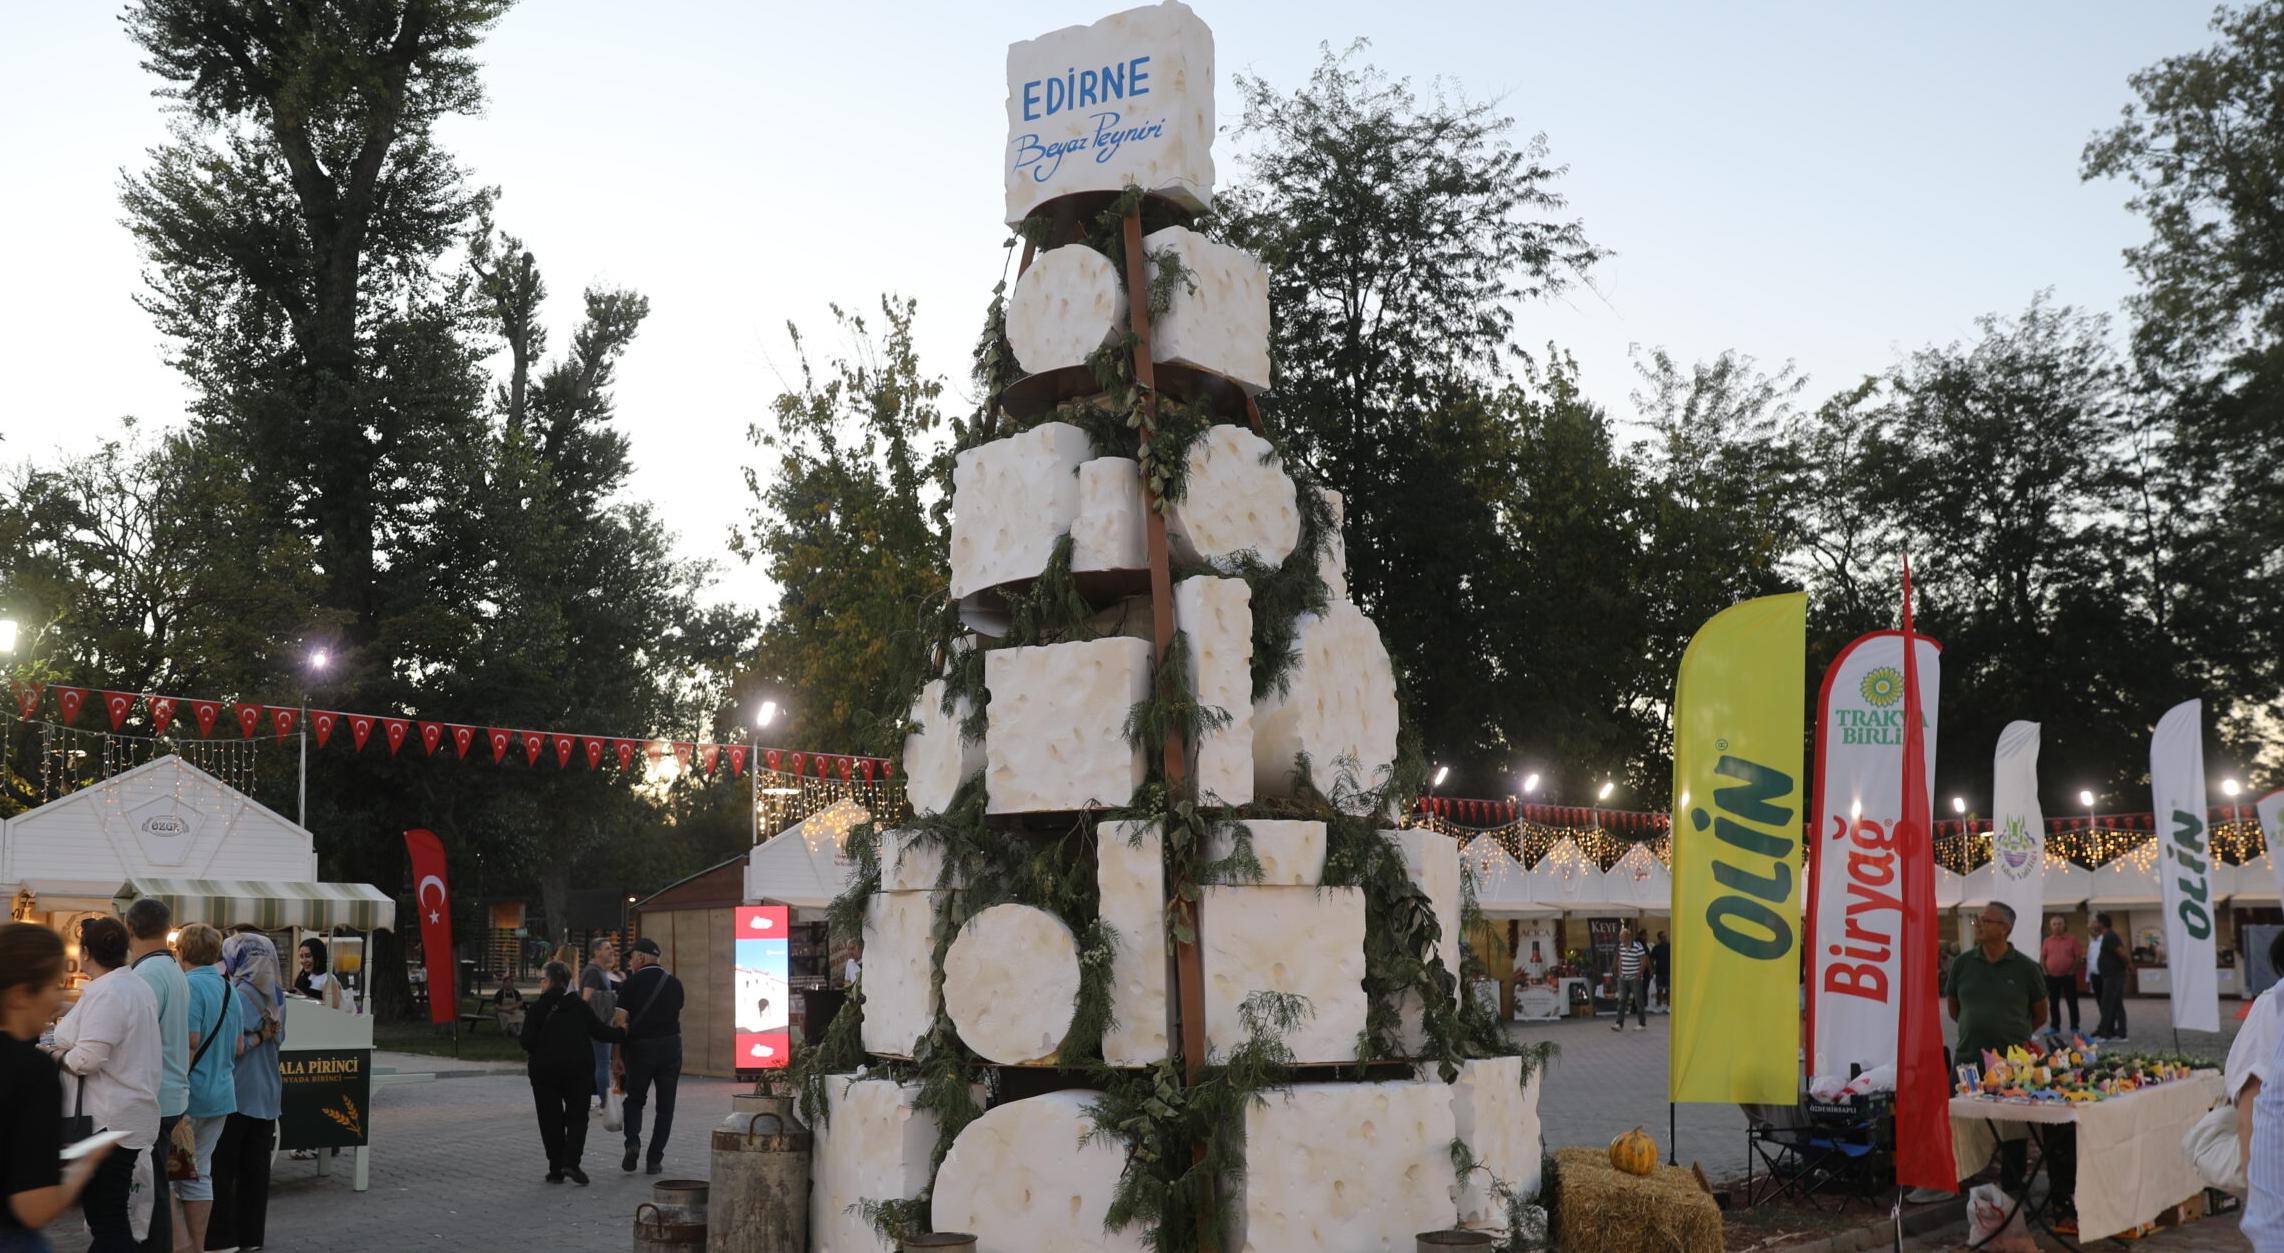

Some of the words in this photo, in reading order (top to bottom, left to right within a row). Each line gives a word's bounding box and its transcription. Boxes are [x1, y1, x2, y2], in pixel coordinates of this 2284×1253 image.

[1023, 56, 1150, 121] EDİRNE
[1012, 133, 1088, 182] Beyaz
[1088, 112, 1166, 164] Peyniri
[1691, 755, 1794, 960] OLİN
[2166, 809, 2211, 940] OLİN
[1824, 815, 1922, 1005] Biryağ
[308, 1056, 359, 1073] PİRİNCİ
